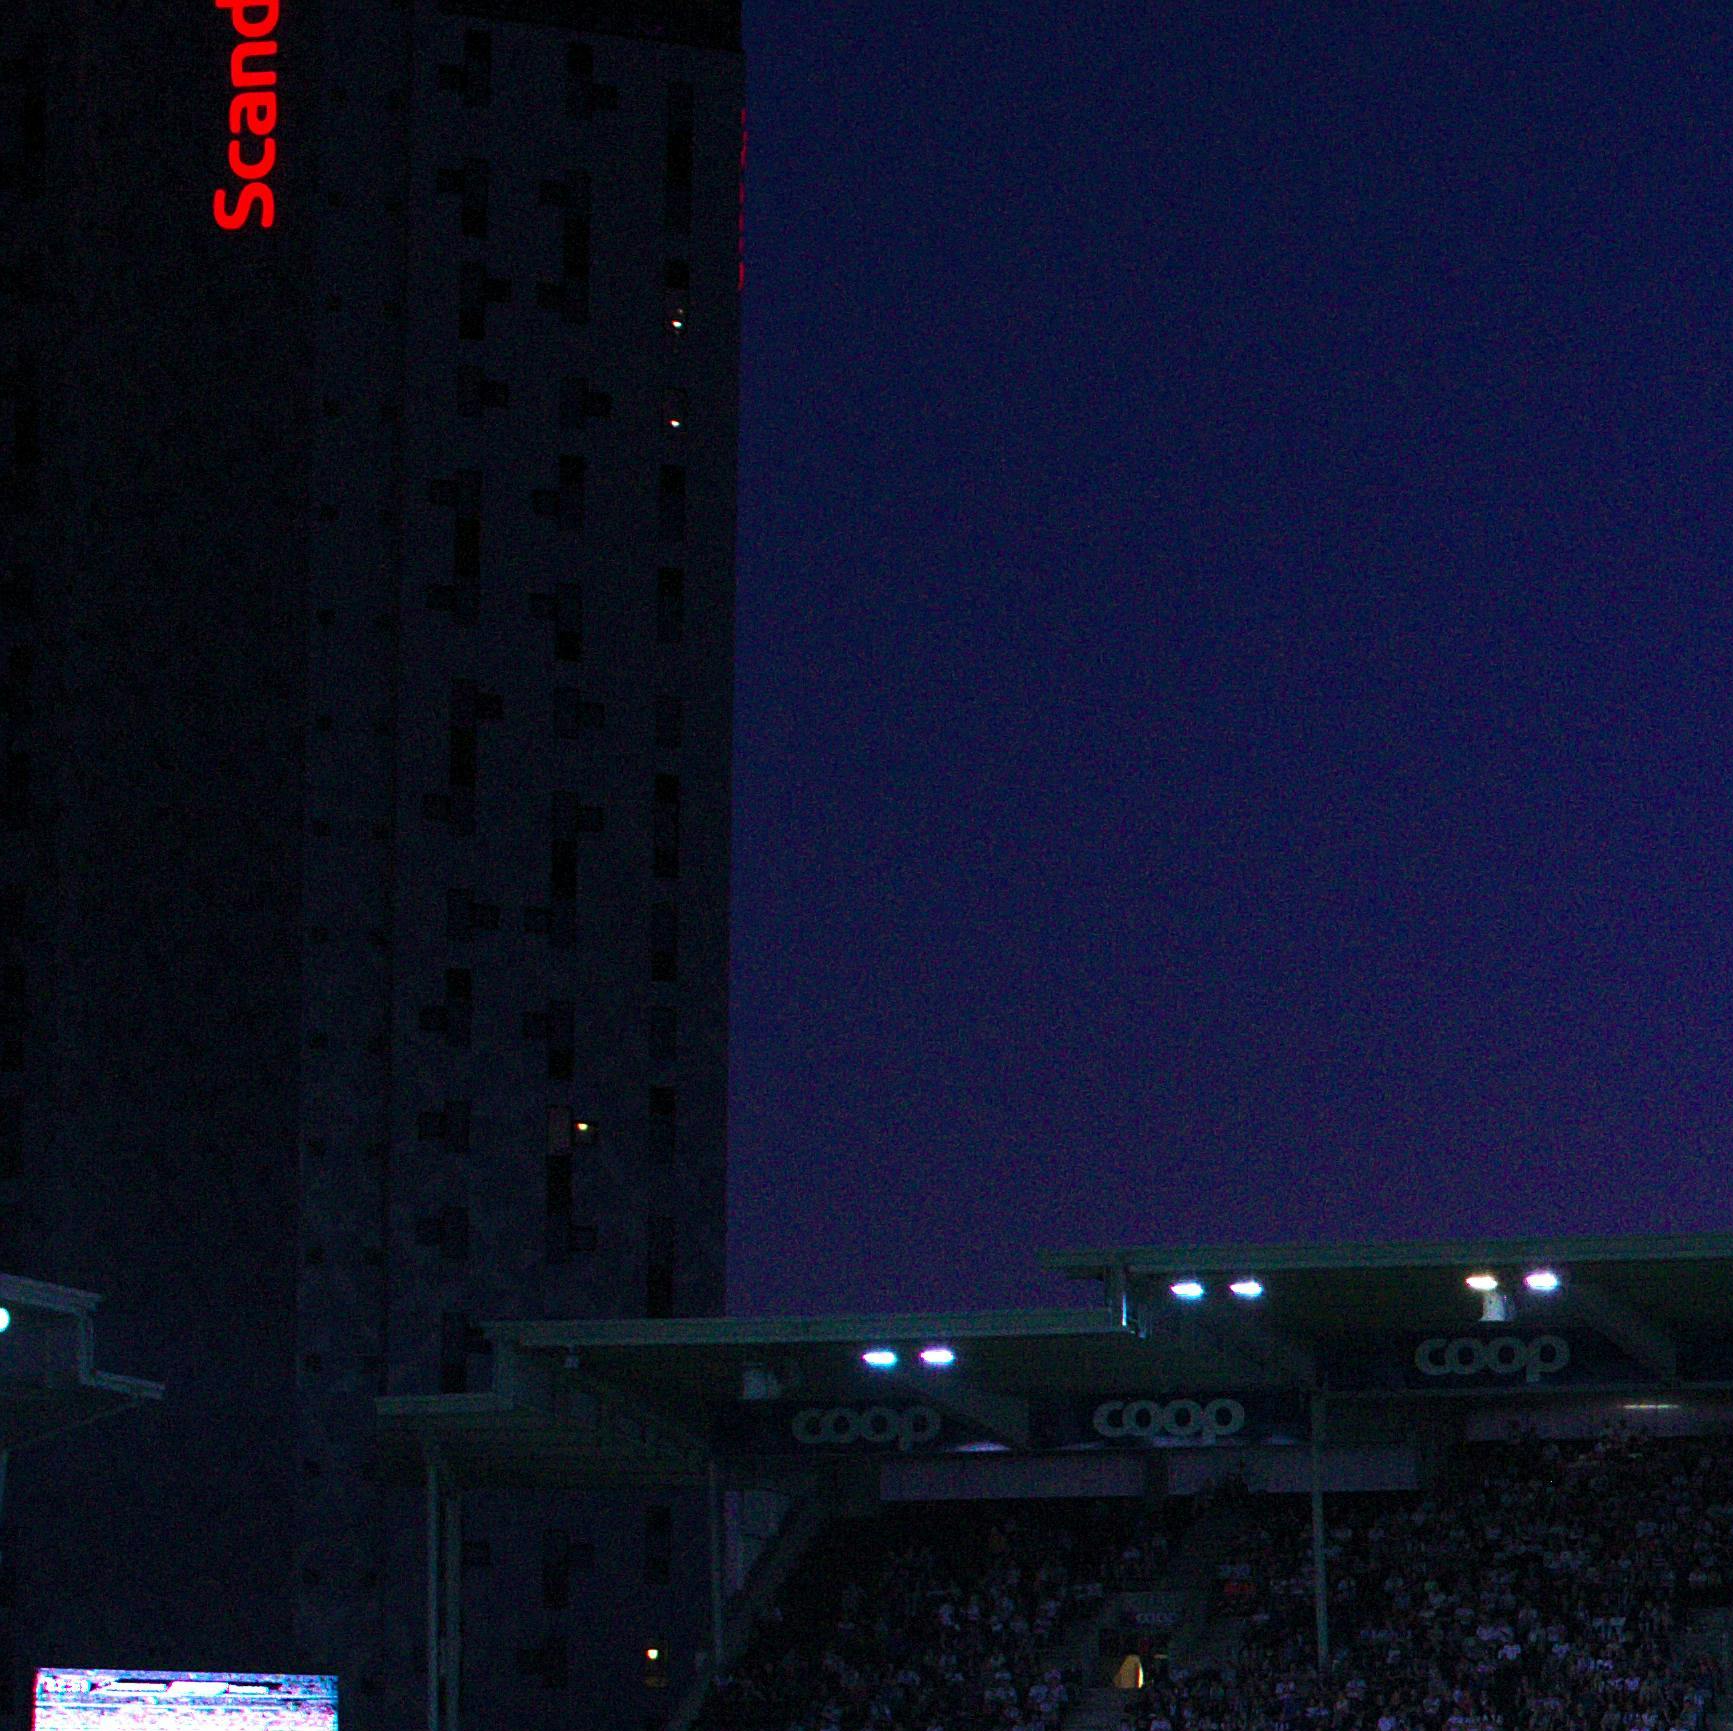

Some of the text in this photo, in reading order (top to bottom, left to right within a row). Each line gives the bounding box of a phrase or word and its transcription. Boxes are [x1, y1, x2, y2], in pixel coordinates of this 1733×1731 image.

[1414, 1335, 1571, 1382] coop
[791, 1406, 942, 1451] coop
[1093, 1398, 1245, 1447] coop
